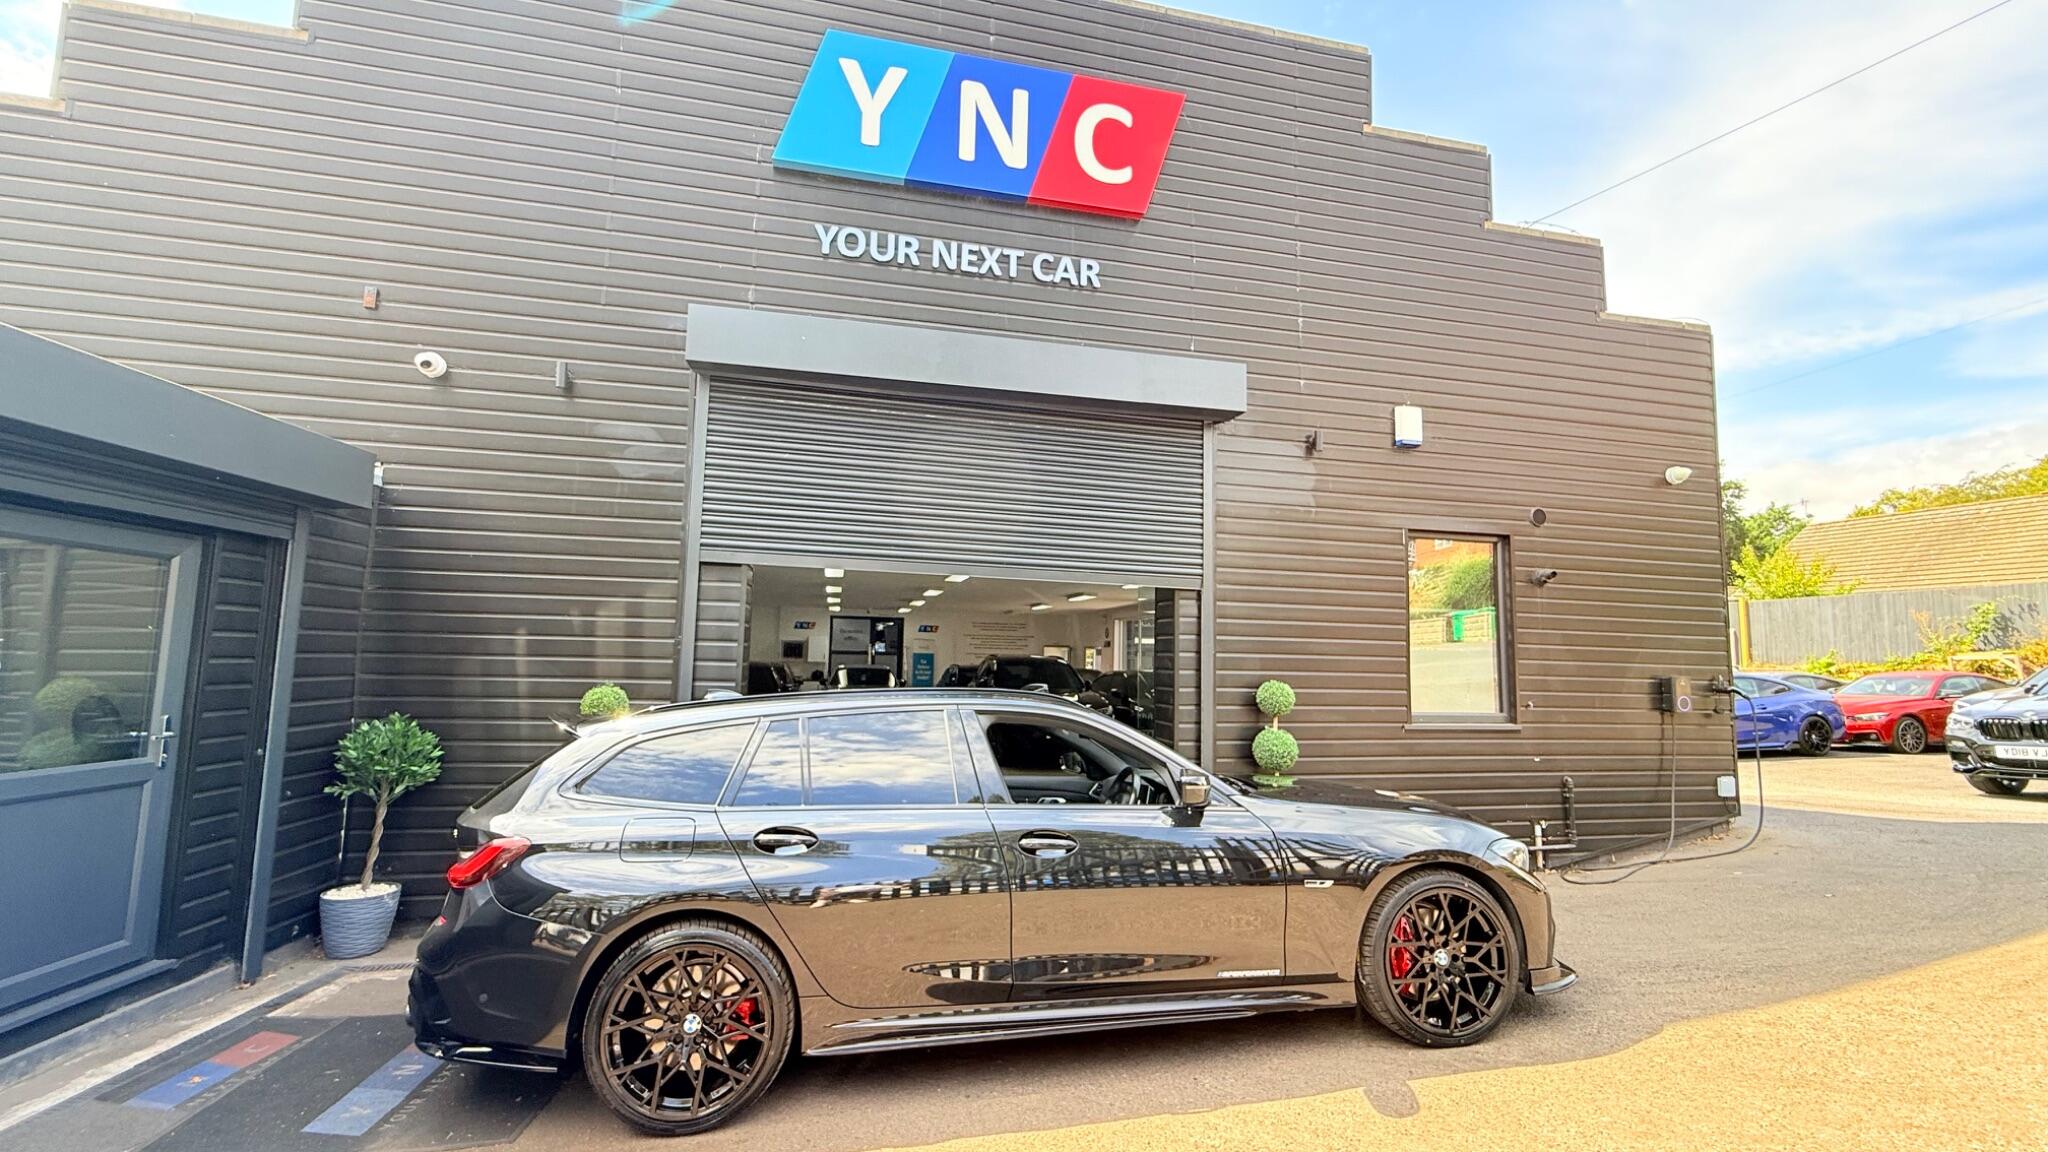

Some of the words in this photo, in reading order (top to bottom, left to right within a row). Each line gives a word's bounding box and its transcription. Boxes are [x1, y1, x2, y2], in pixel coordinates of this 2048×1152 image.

[838, 57, 1133, 184] YNC
[814, 223, 920, 267] YOUR
[932, 240, 1024, 278] NEXT
[1032, 252, 1101, 288] CAR
